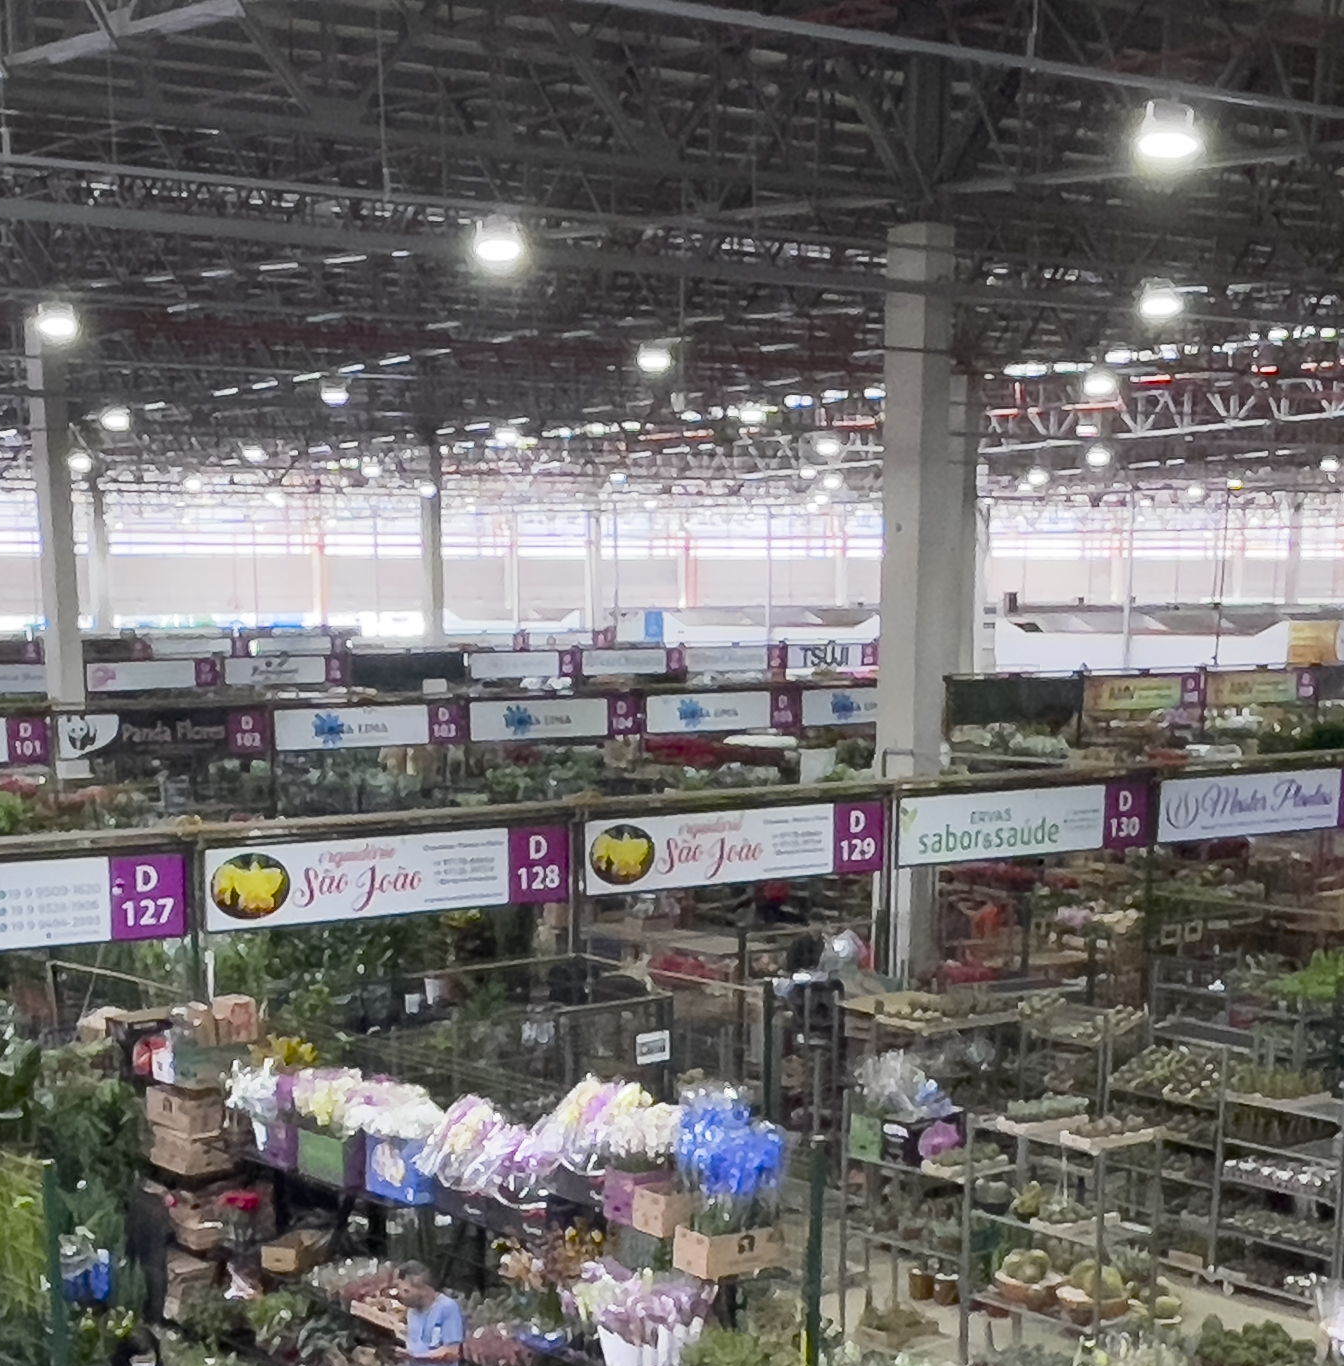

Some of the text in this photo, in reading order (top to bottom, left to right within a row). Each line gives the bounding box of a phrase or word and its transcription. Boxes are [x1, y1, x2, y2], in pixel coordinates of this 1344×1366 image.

[240, 715, 253, 729] D
[438, 707, 450, 721] D
[19, 723, 33, 738] D
[121, 717, 226, 743] Panda Flores
[14, 740, 42, 757] 101
[1118, 790, 1133, 812] D
[849, 810, 866, 834] D
[1109, 817, 1140, 838] 130
[528, 835, 548, 860] D
[657, 837, 704, 875] São
[706, 837, 764, 880] João
[839, 837, 876, 862] 129
[134, 864, 159, 893] D
[292, 866, 349, 909] São
[354, 865, 422, 912] João
[516, 865, 561, 891] 128
[121, 896, 175, 927] 127
